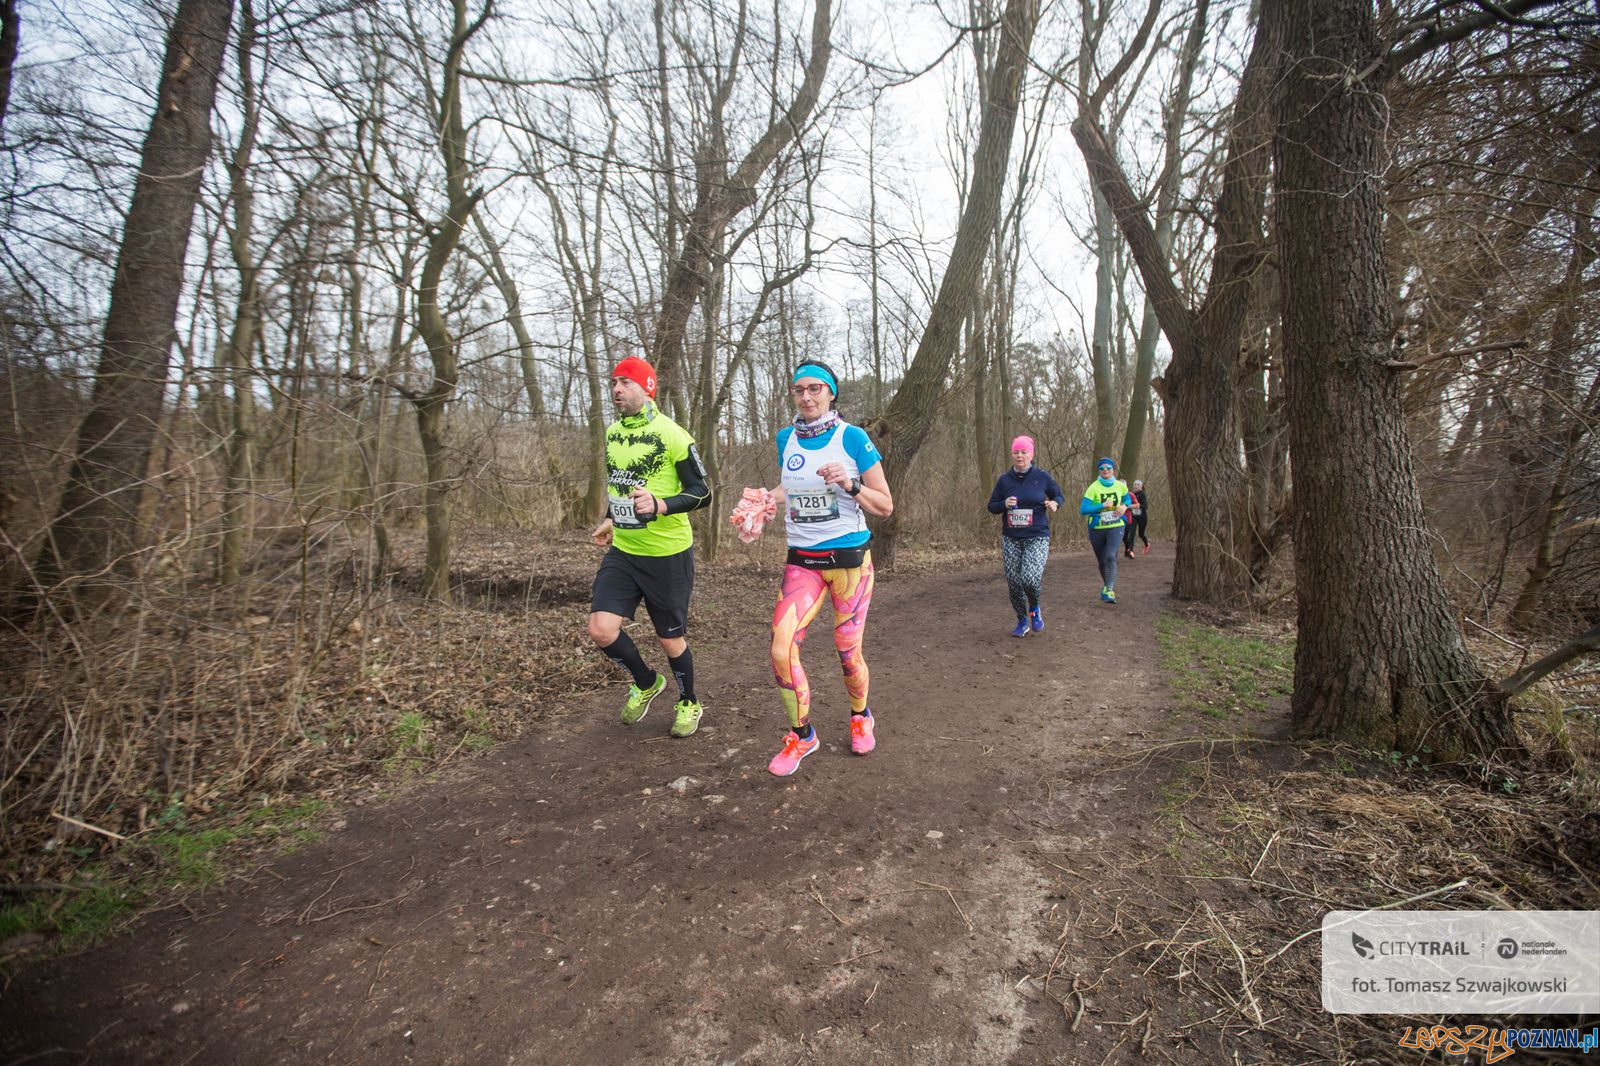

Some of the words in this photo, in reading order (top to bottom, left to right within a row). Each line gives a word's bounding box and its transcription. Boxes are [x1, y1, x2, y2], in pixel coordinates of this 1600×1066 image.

[611, 469, 636, 479] DIRTY
[797, 495, 828, 509] 1281
[613, 505, 633, 517] 601
